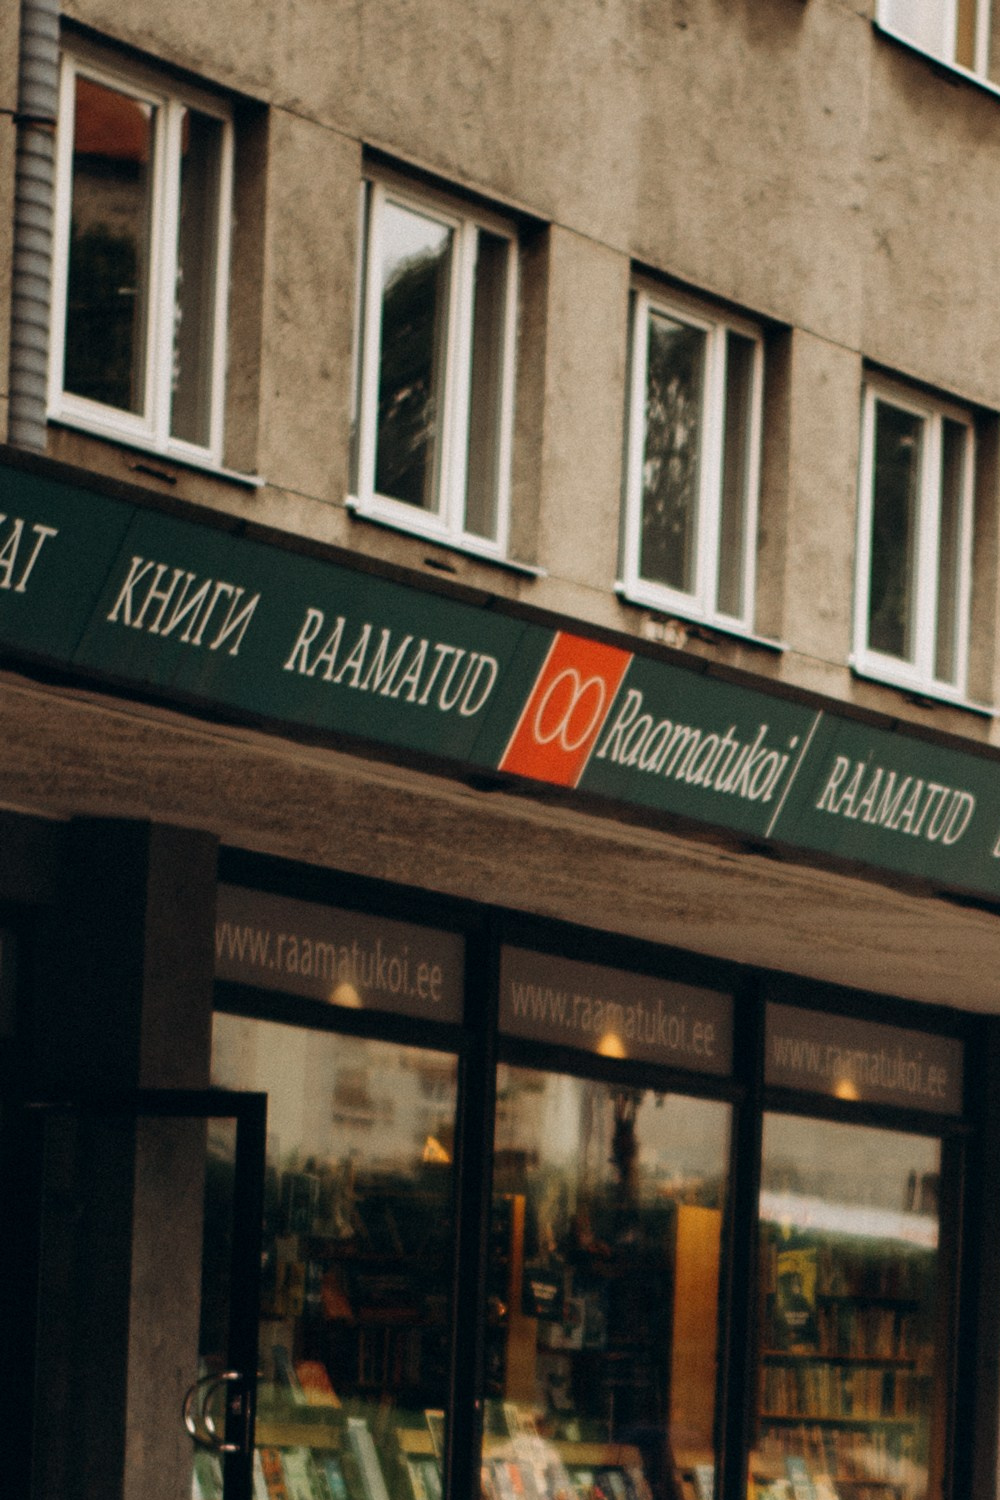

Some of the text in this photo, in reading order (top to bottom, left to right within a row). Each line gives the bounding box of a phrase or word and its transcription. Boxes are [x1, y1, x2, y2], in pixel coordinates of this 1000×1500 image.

[0, 513, 58, 593] AT
[107, 556, 261, 656] КНИГИ
[283, 607, 499, 717] RAAMATUD
[597, 688, 797, 802] Raamatukoi
[815, 755, 976, 846] RAAMATUD
[511, 980, 715, 1057] www.raamatukoi.ee
